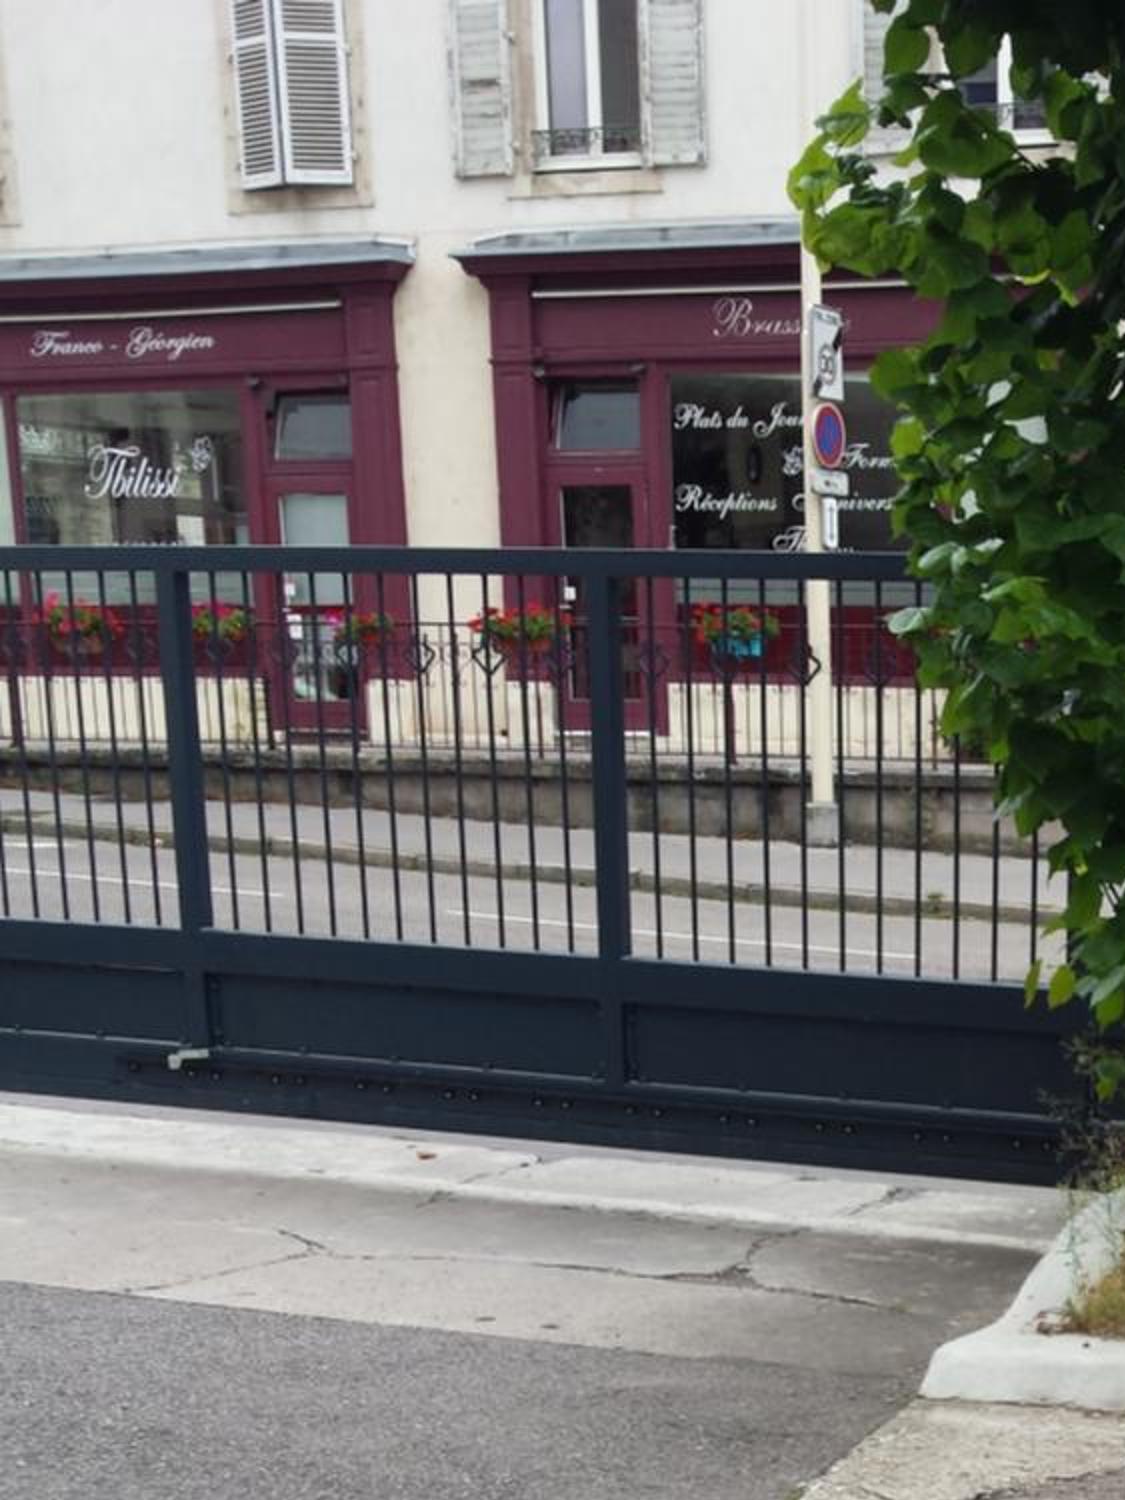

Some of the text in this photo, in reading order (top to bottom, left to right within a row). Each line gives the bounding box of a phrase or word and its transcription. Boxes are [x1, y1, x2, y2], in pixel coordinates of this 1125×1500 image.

[713, 298, 850, 337] Brass
[31, 330, 102, 357] Franco
[126, 326, 215, 360] Géorgien
[674, 403, 722, 429] Plats
[727, 406, 749, 428] du
[84, 444, 178, 499] Tbilissi
[676, 484, 777, 519] Réceptions
